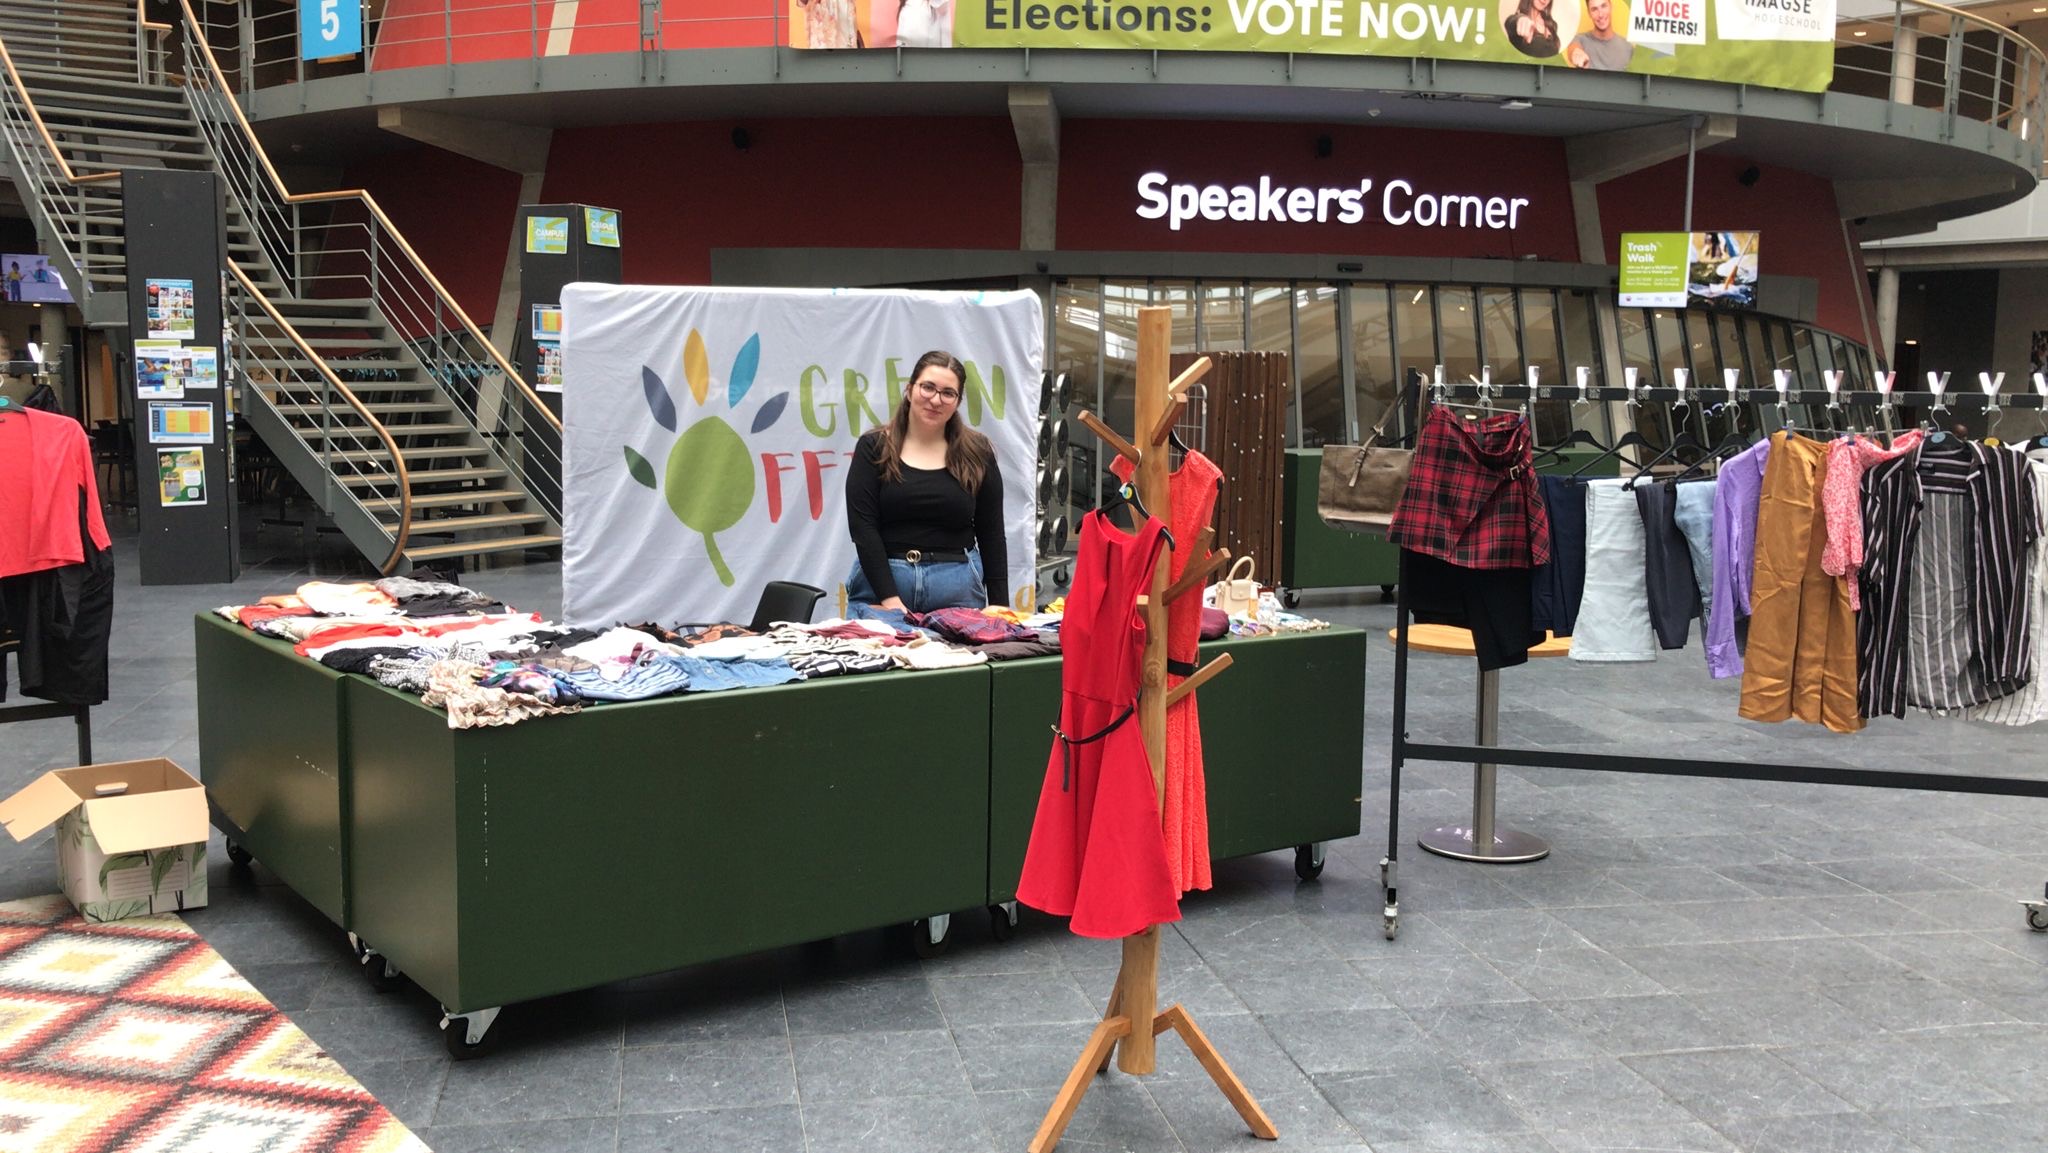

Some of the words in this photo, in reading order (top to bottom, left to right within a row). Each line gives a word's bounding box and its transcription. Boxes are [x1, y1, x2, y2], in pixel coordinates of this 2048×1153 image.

[321, 0, 340, 41] 5
[985, 0, 1212, 32] Elections:
[1230, 0, 1344, 36] VOTE
[1359, 1, 1487, 45] NOW!
[1644, 0, 1690, 20] VOICE
[1634, 16, 1698, 37] MATTERS!
[1382, 179, 1530, 230] Corner
[1627, 242, 1656, 252] Trash
[1627, 253, 1655, 263] Walk
[800, 357, 1006, 439] GREN
